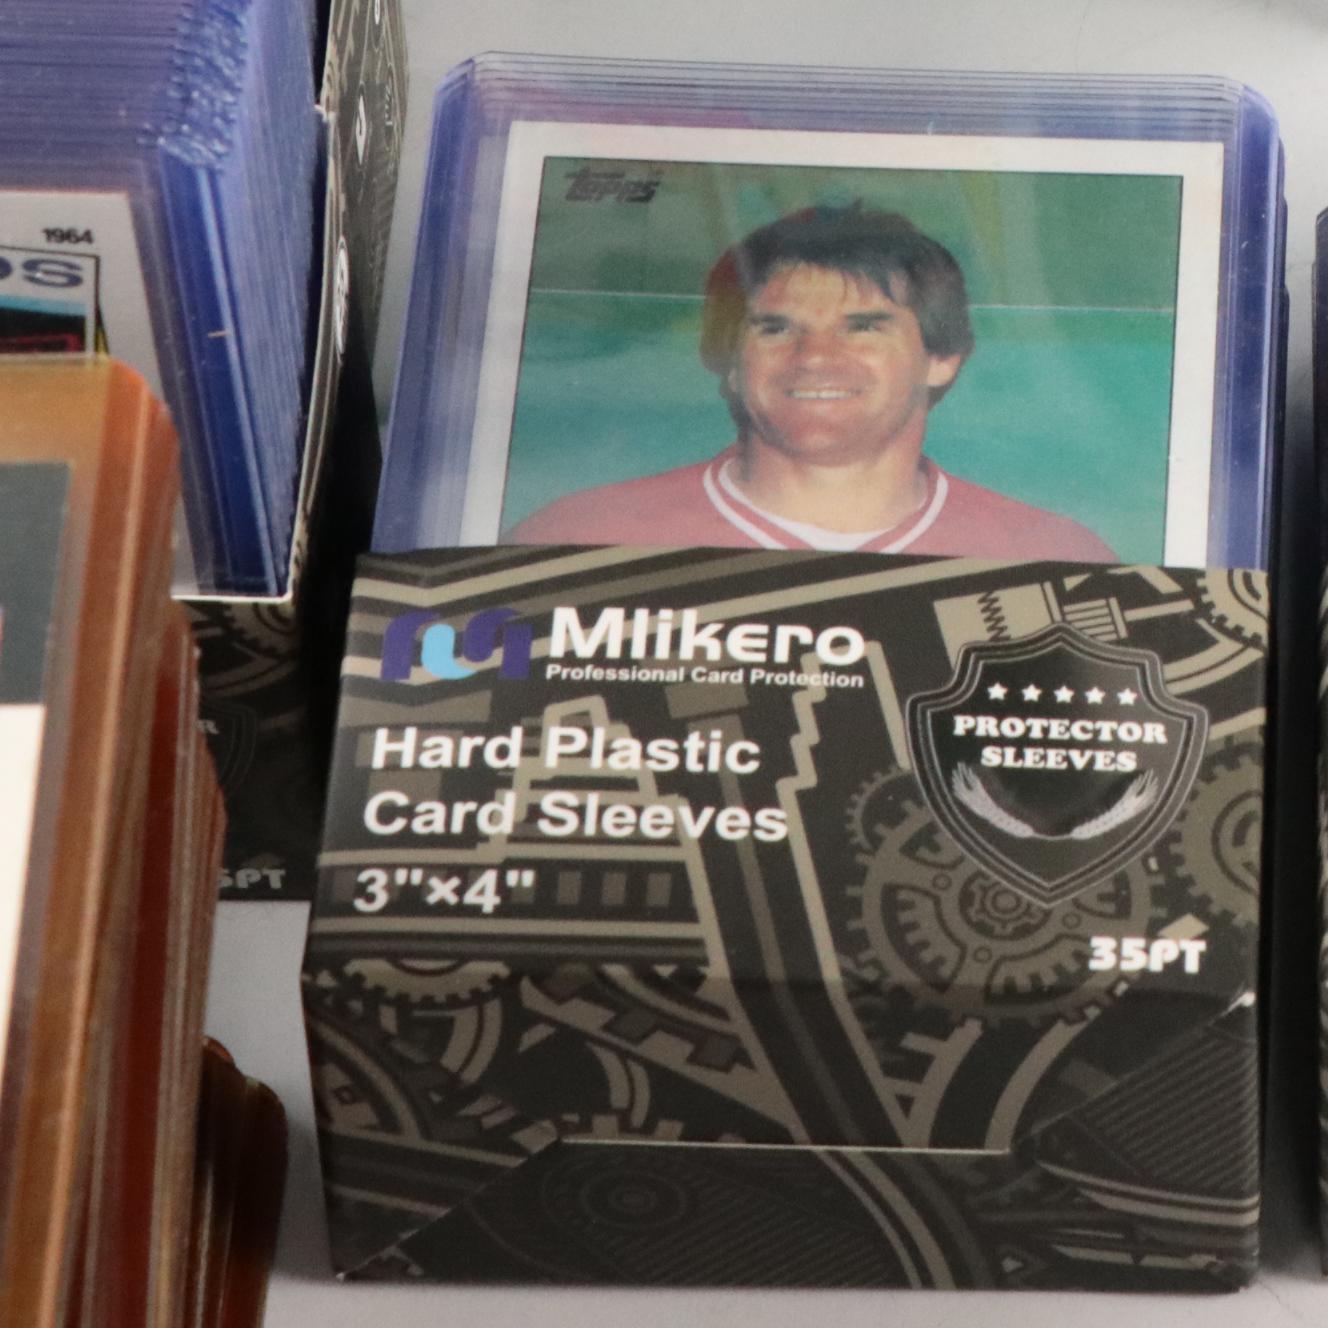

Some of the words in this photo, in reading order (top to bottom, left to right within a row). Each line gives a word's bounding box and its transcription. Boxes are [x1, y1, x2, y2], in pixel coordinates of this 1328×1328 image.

[42, 227, 94, 245] 1964
[550, 606, 865, 666] Mlikero
[545, 662, 685, 684] Professional
[691, 666, 743, 685] Card
[750, 668, 864, 689] Protection
[953, 714, 1168, 744] PROTECTOR
[371, 726, 522, 770] Hard
[545, 726, 761, 774] Plastic
[980, 746, 1137, 772] SLEEVES
[363, 790, 515, 836] Card
[537, 792, 788, 843] Sleeves
[1088, 935, 1206, 974] 35PT
